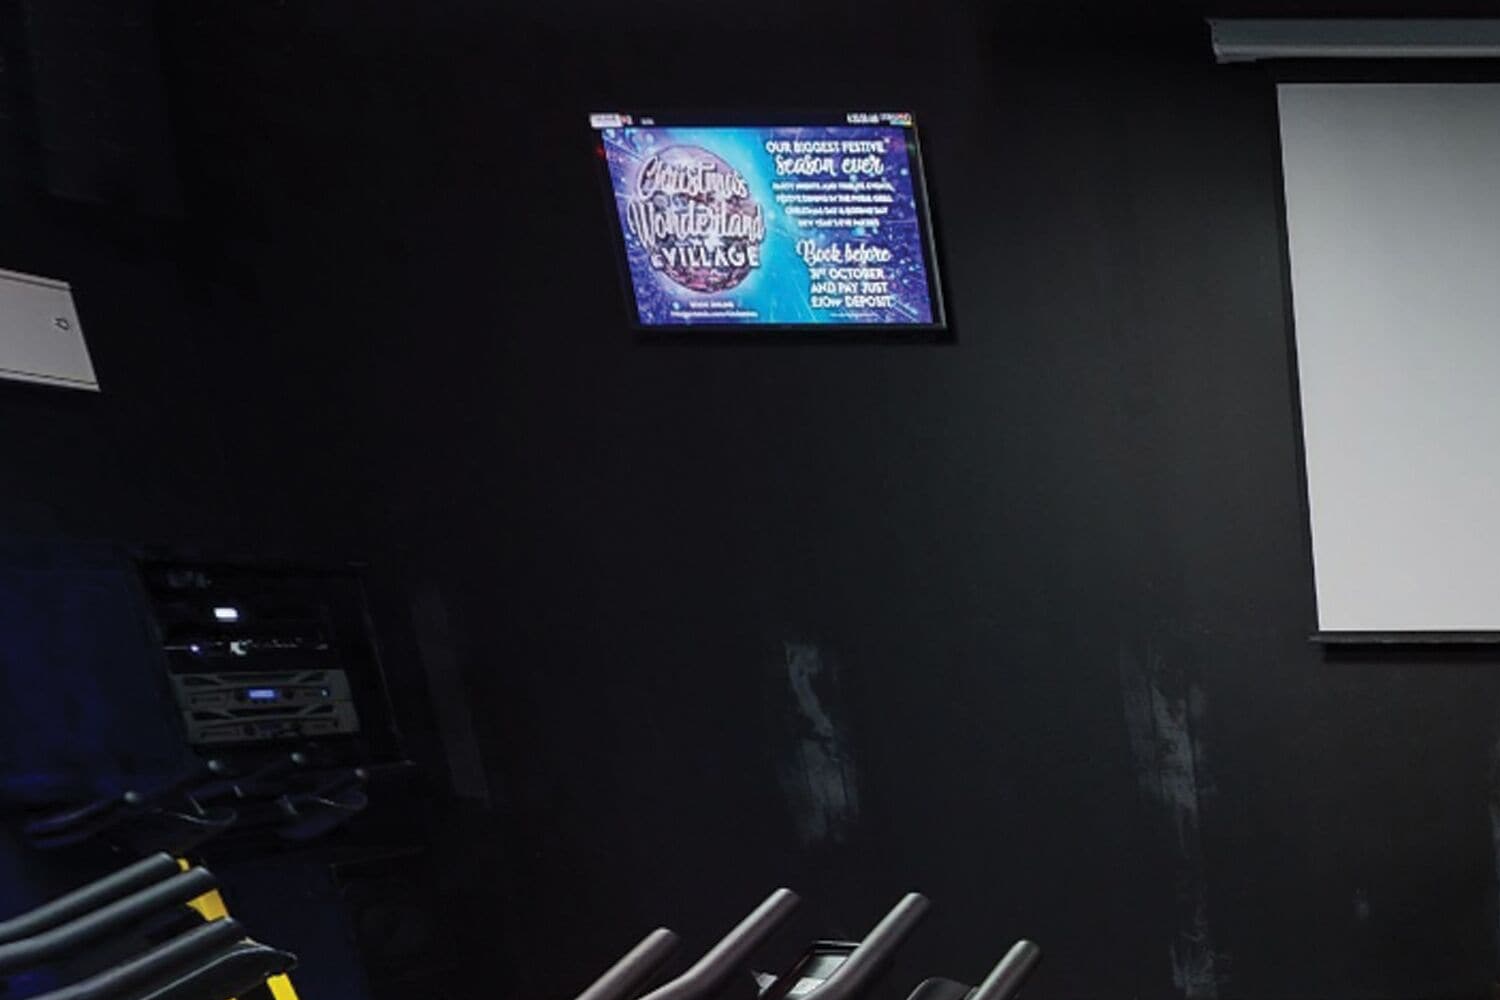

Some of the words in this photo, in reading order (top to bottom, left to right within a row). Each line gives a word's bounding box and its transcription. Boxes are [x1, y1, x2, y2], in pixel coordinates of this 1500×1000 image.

[661, 246, 761, 267] VILLAGE
[828, 267, 884, 280] OCTOBER
[811, 281, 836, 294] AND
[838, 281, 858, 294] PAY
[861, 281, 888, 294] JUST
[844, 295, 893, 308] DEPOSIT
